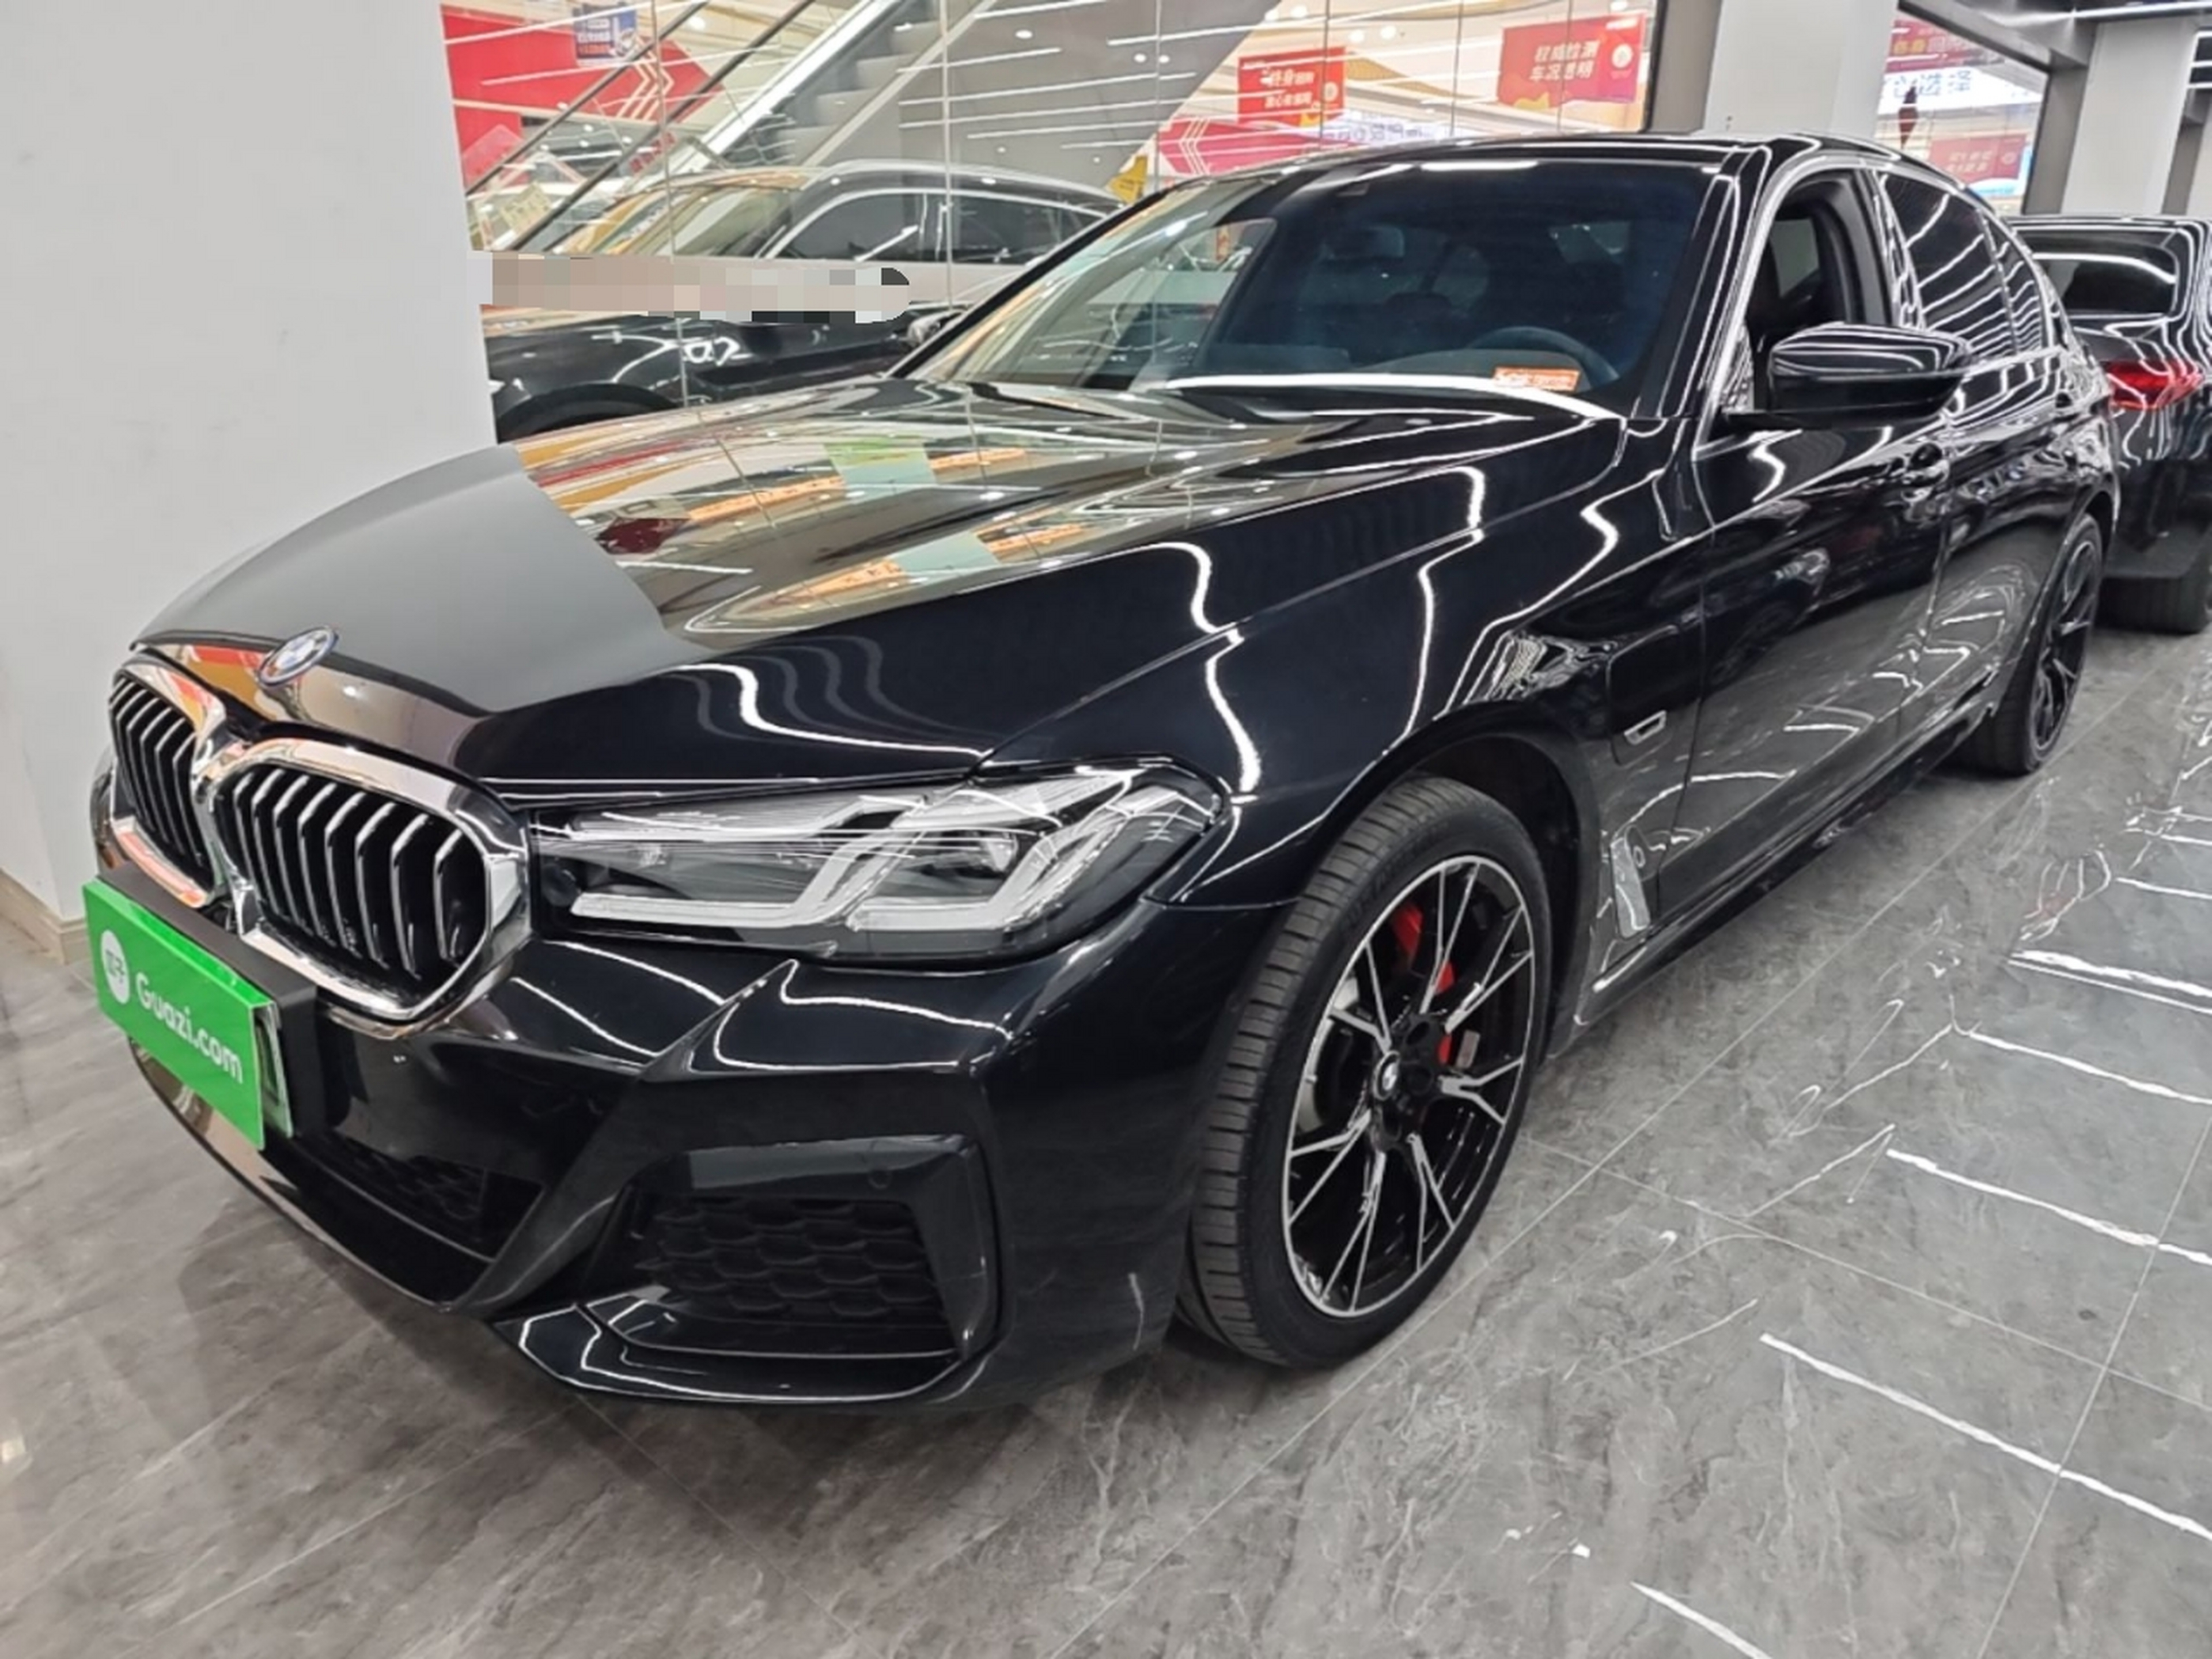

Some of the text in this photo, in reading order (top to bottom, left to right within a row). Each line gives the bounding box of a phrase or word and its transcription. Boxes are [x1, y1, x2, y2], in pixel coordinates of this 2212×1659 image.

[1534, 40, 1601, 63] 权威检测
[1529, 60, 1594, 82] 车况透明
[136, 972, 243, 1084] Guazi.com
